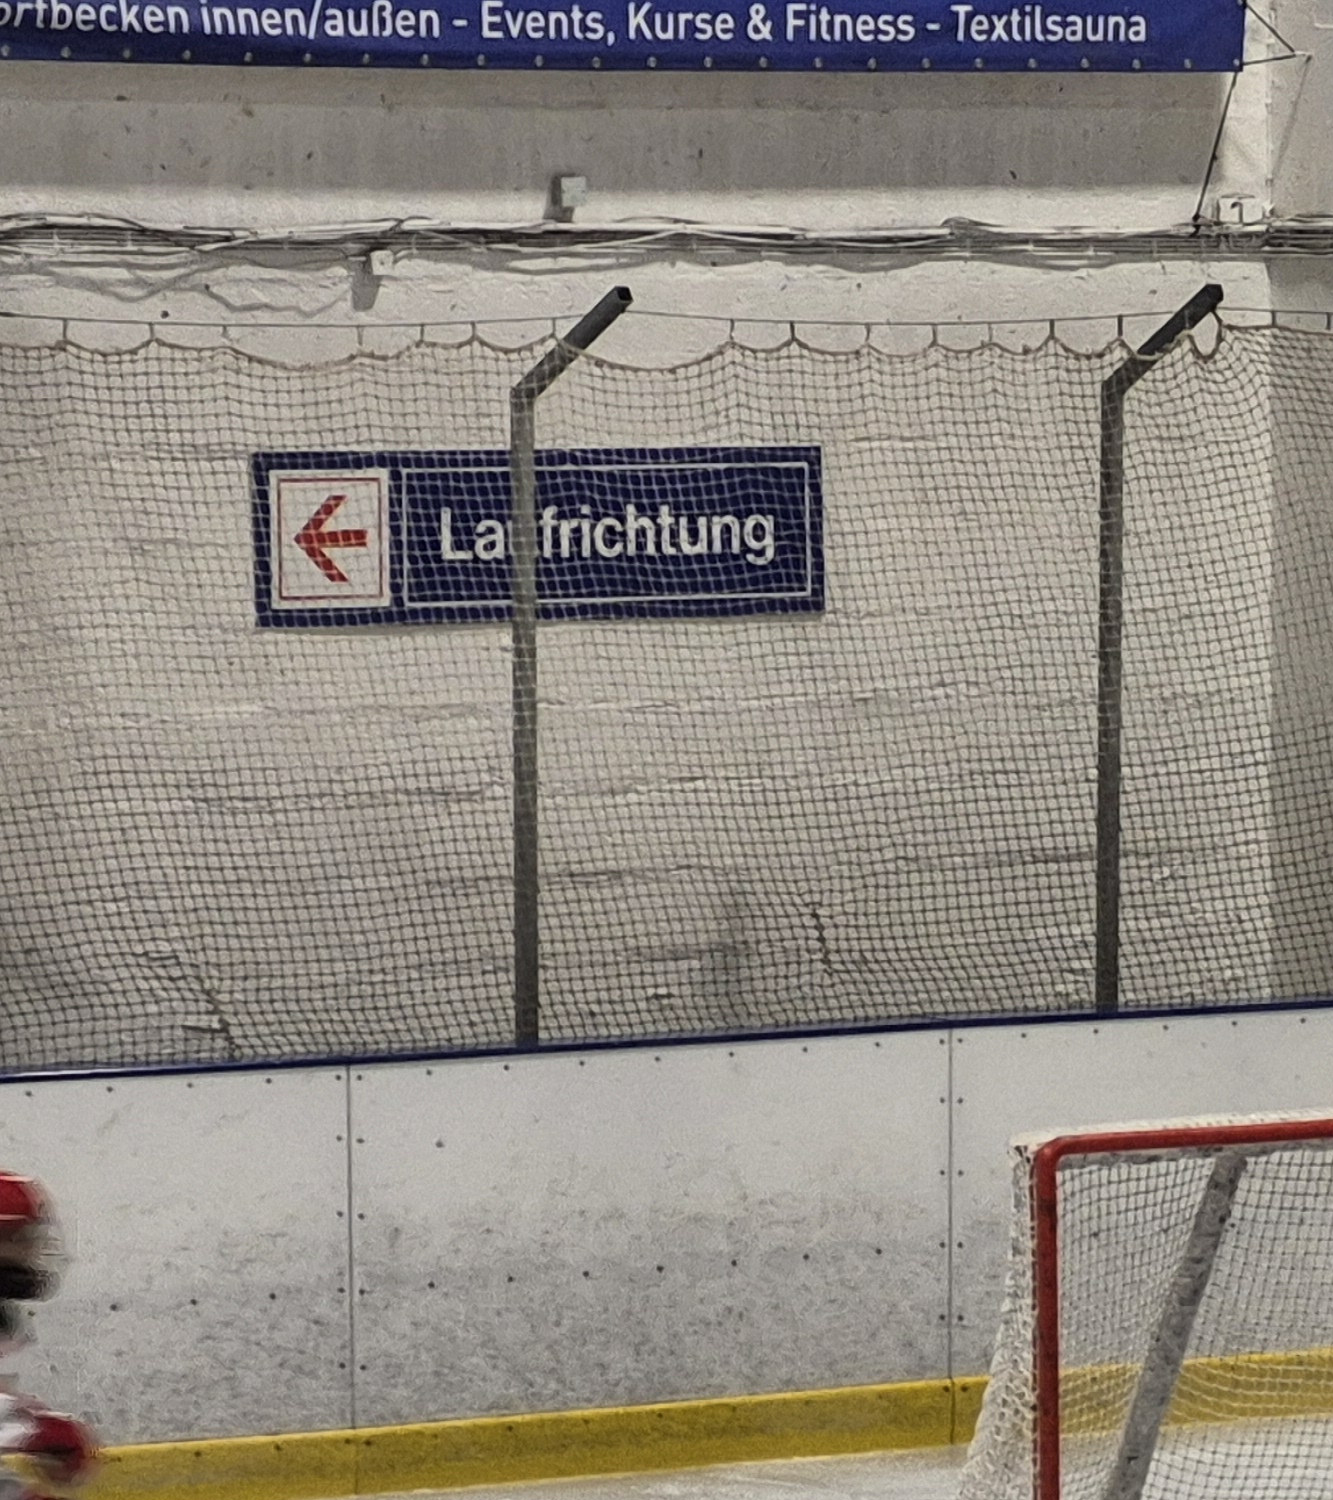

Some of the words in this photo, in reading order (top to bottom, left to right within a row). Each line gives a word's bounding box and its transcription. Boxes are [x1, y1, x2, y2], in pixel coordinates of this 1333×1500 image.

[201, 0, 440, 40] innen/außen
[481, 0, 615, 46] Events,
[628, 1, 734, 41] Kurse
[747, 3, 773, 41] &
[785, 3, 916, 43] Fitness
[951, 4, 1147, 43] Textilsauna
[440, 503, 776, 566] Lafrichtung
